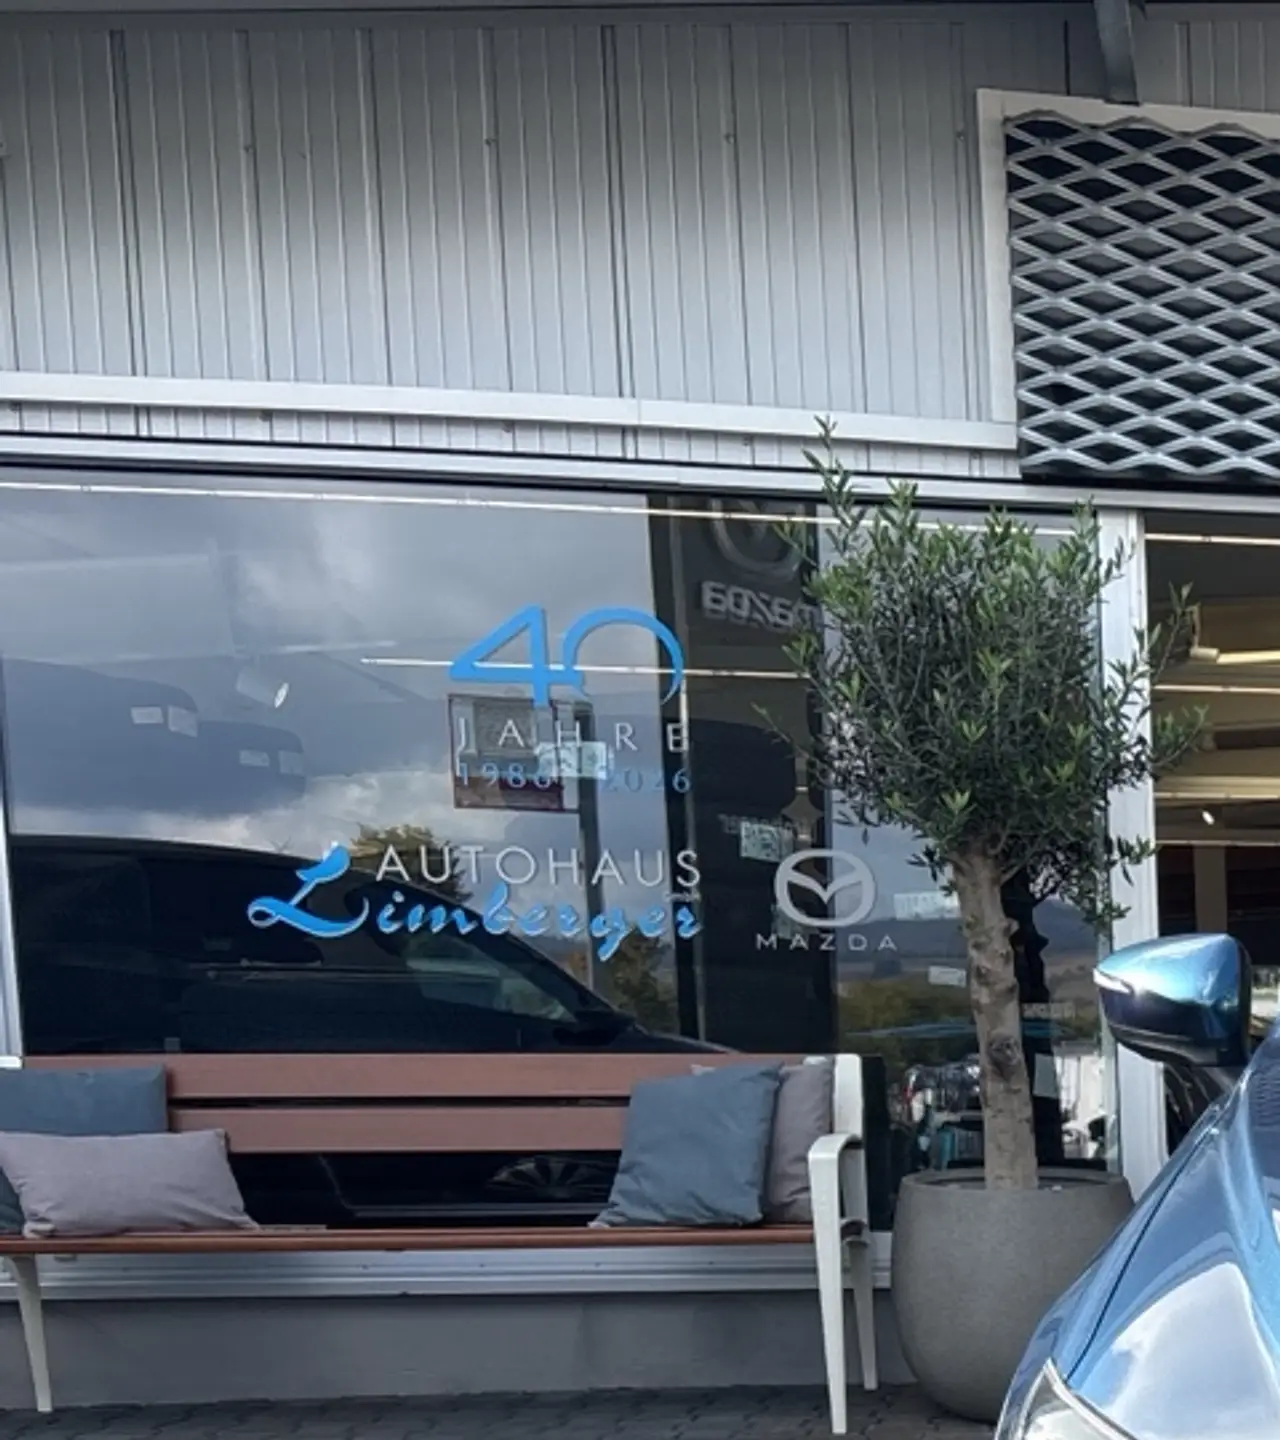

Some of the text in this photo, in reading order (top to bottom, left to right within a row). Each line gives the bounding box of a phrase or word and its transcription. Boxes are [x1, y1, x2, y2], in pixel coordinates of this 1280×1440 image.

[447, 604, 685, 708] 40
[457, 716, 690, 752] JAHRE
[376, 844, 702, 887] AUTOHAUS
[246, 840, 703, 962] Limberger
[756, 933, 898, 951] MAZDA
